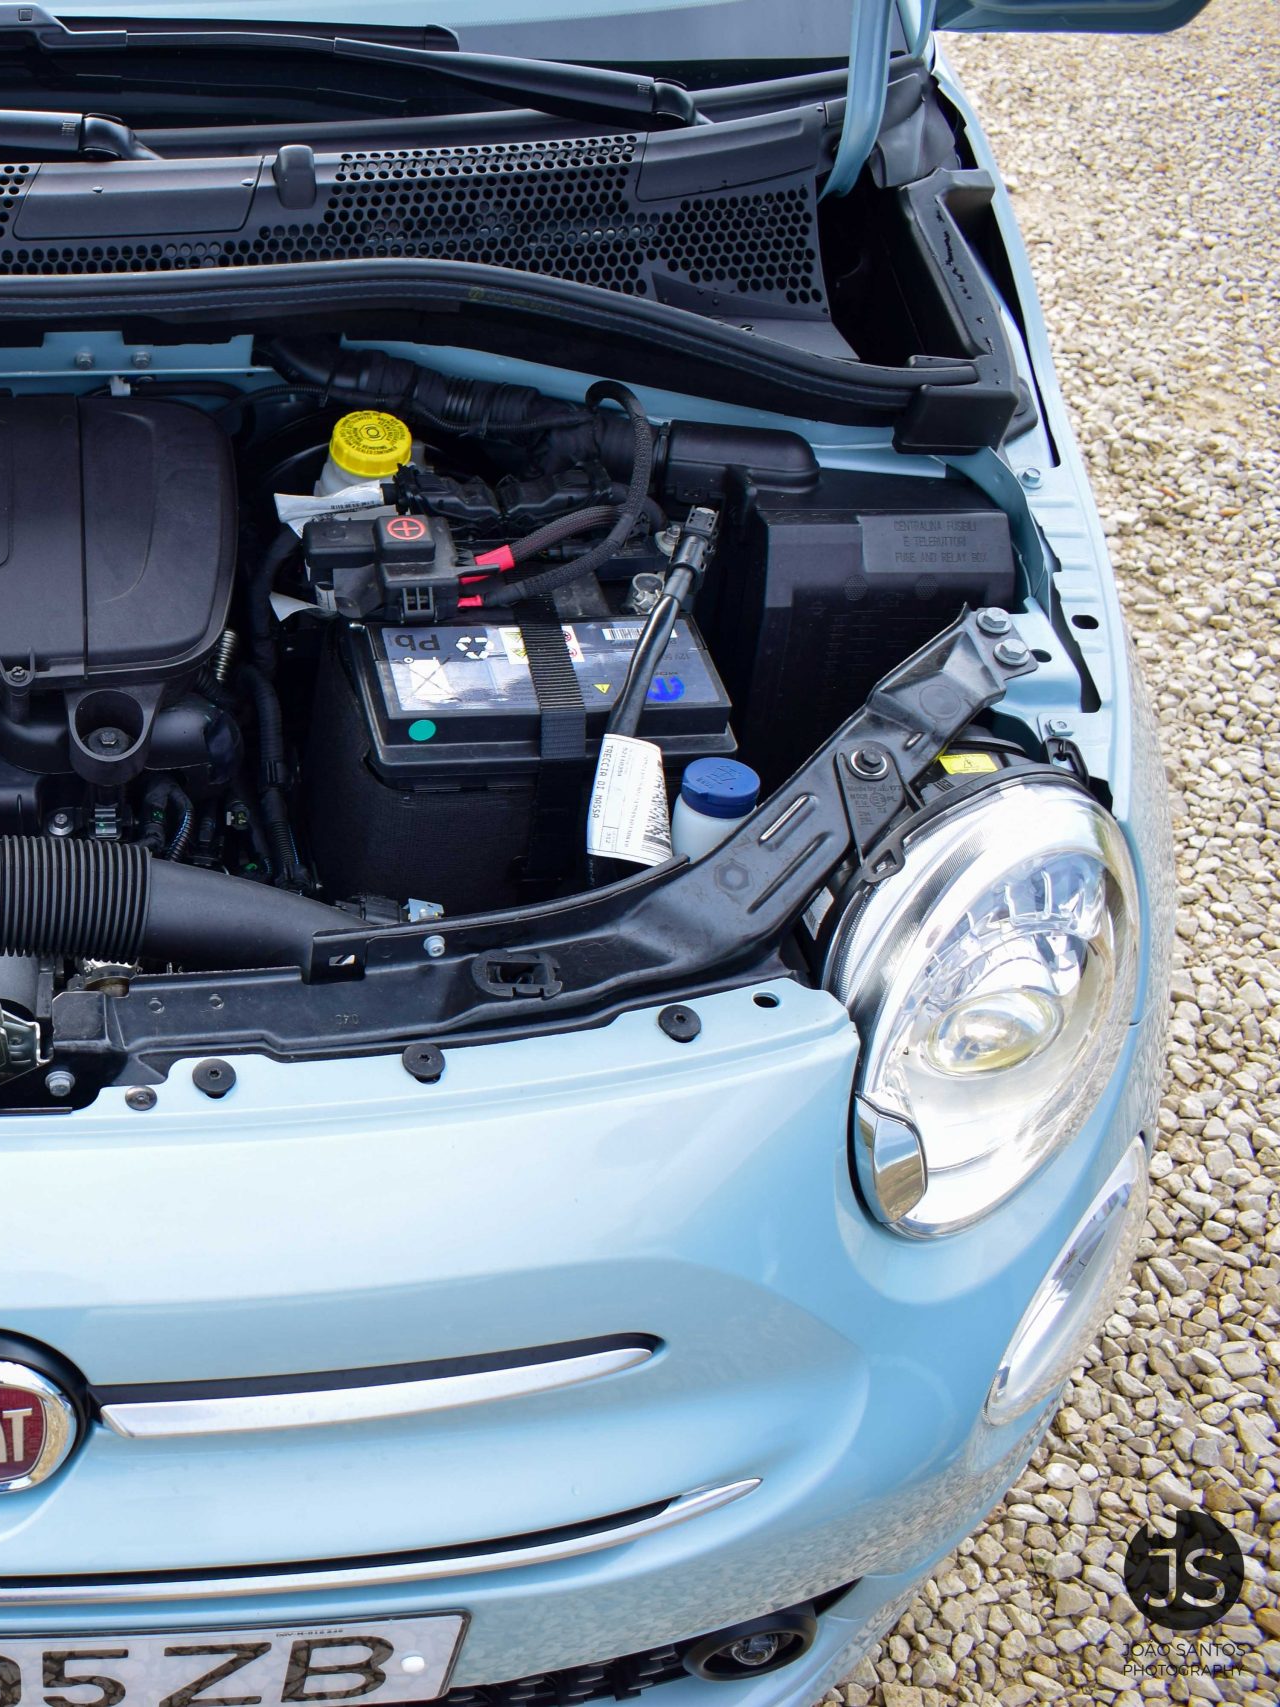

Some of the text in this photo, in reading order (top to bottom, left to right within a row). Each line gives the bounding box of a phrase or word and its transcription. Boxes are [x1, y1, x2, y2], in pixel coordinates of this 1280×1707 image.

[893, 520, 942, 532] CENTRALINA
[895, 552, 989, 563] FUSE AND RELAY BOX
[394, 634, 441, 651] Pb
[592, 745, 614, 819] TRECCIA DI MASSA
[158, 1635, 394, 1707] ZB
